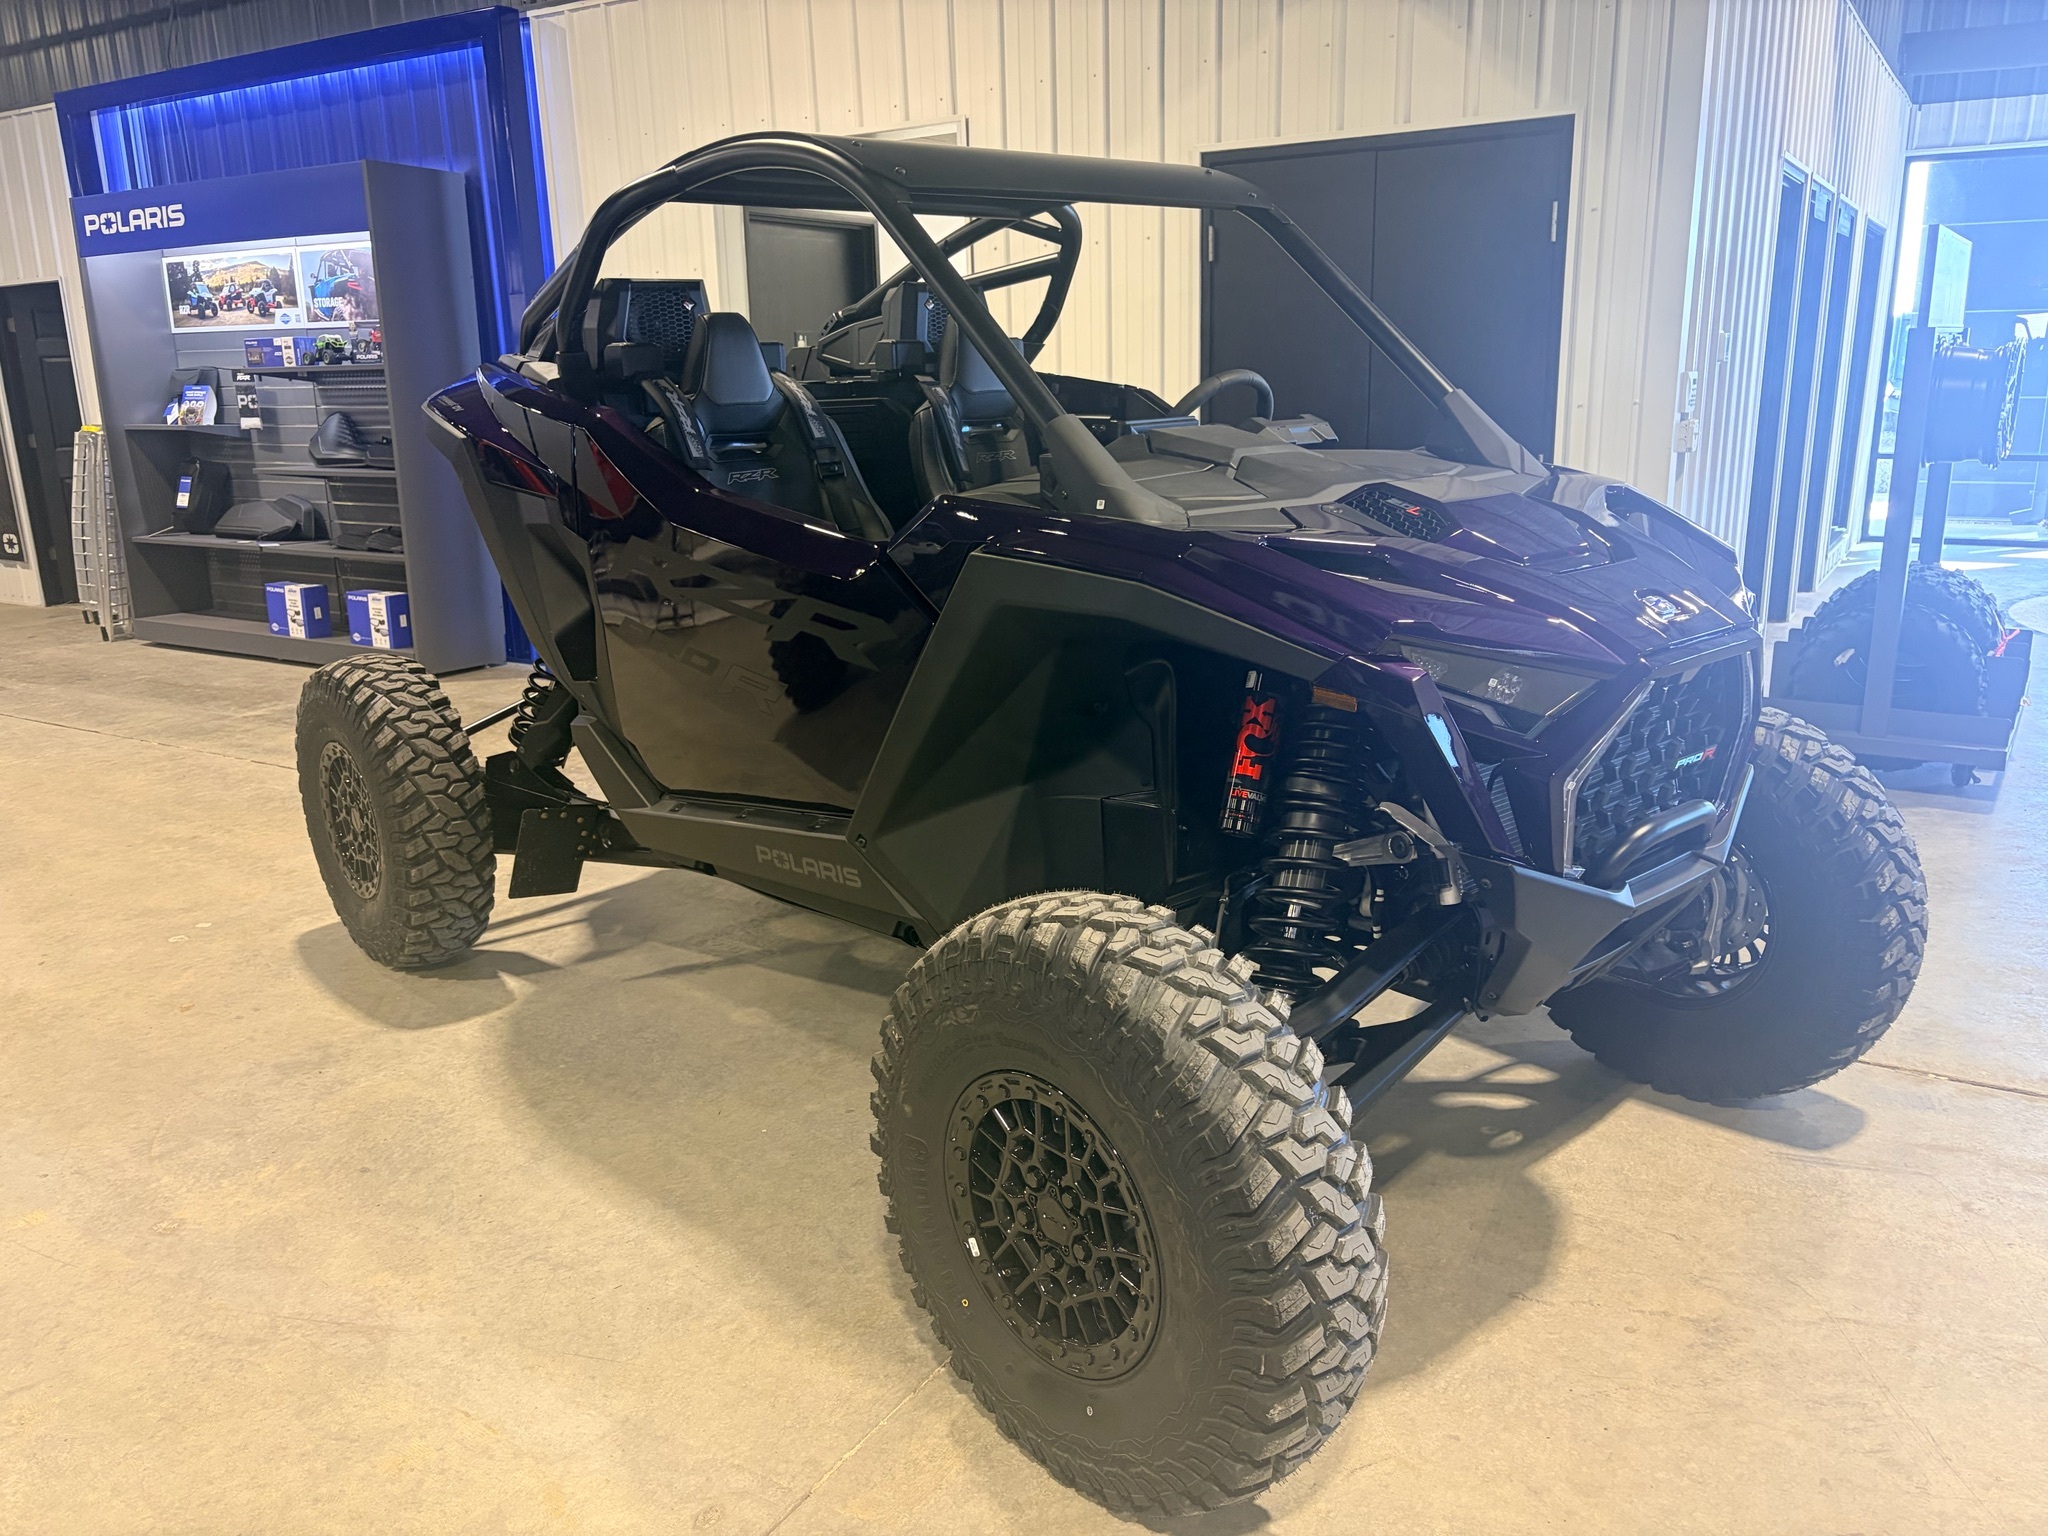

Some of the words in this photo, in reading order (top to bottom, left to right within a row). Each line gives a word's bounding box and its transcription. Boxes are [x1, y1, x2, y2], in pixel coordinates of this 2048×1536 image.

[83, 203, 186, 237] POLARIS
[313, 297, 343, 308] STORAGE
[976, 450, 1017, 464] RZR
[727, 467, 780, 485] RZR
[1231, 695, 1278, 781] FOX
[755, 845, 862, 888] POLARIS
